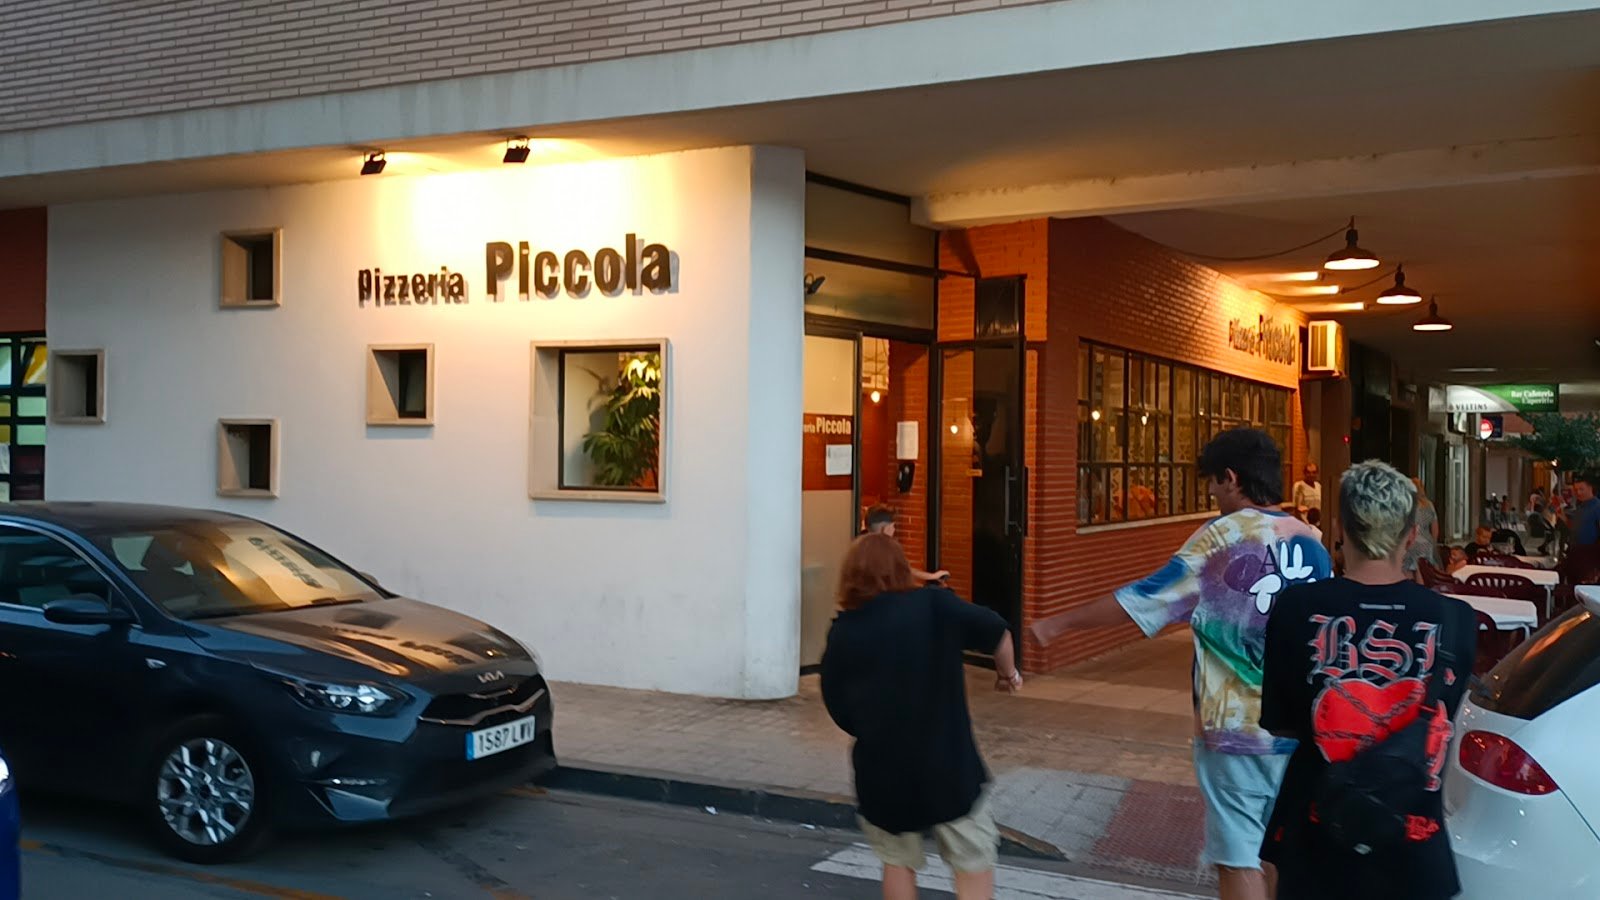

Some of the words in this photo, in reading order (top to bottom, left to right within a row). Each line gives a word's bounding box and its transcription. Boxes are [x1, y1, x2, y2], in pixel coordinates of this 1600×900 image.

[358, 266, 466, 304] Pizzeria
[485, 233, 674, 297] Piccola
[816, 417, 852, 434] Piccola
[477, 670, 505, 683] KIA
[478, 727, 510, 753] 1587
